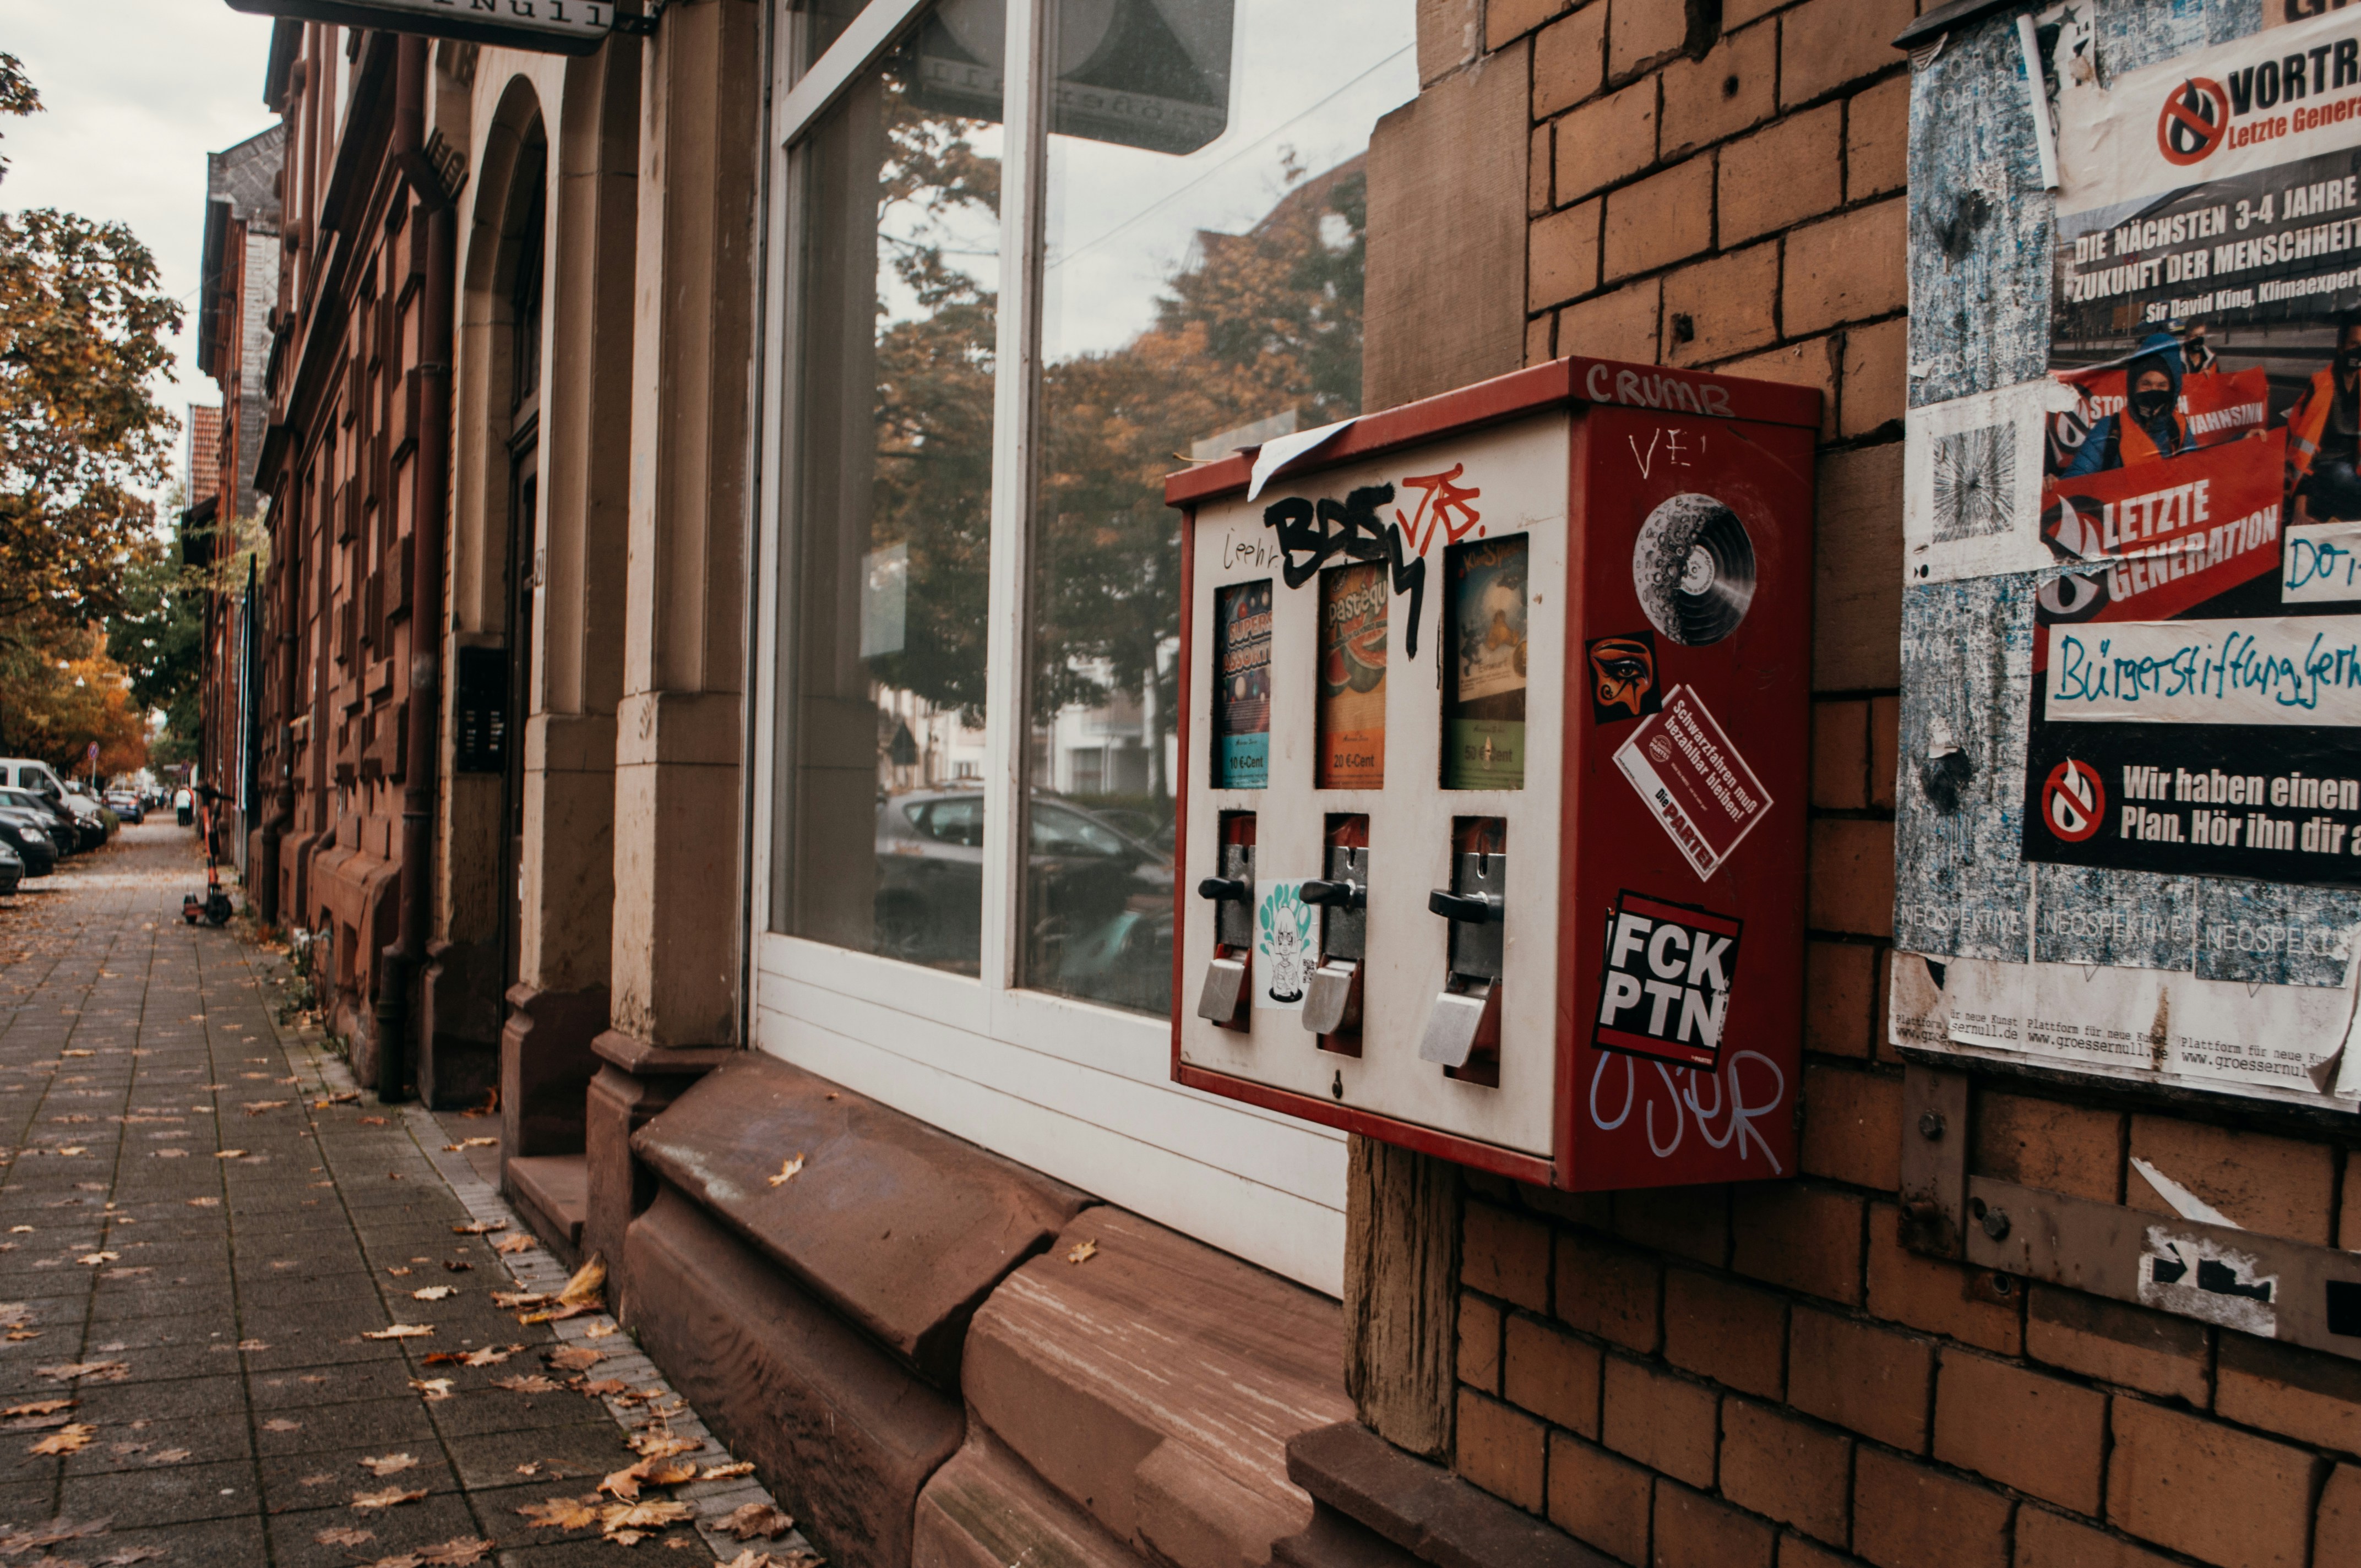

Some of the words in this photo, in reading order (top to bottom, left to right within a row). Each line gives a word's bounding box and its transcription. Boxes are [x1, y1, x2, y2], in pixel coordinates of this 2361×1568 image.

[434, 0, 608, 27] Null
[2228, 37, 2361, 117] VORTR
[2227, 116, 2287, 150] Letzte
[2075, 231, 2108, 265] DIE
[2115, 205, 2227, 255] NÄCHSTEN
[2235, 194, 2274, 231] 3-4
[2282, 175, 2357, 220] JAHRE
[2072, 258, 2169, 303] ZUKUNFT
[2166, 248, 2209, 284] DER
[2146, 303, 2169, 324] Sir
[2170, 294, 2213, 319] David
[2090, 395, 2127, 420] STO
[2103, 478, 2210, 549] LETZTE
[2107, 504, 2278, 603] GENERATION
[1229, 756, 1238, 769] 10
[1240, 754, 1263, 769] €-Cent
[1334, 754, 1344, 768] 20
[1346, 754, 1375, 767] €-Cent
[1664, 715, 1709, 775] bezahlbar
[1705, 772, 1744, 823] bleiben!
[1672, 699, 1737, 788] Schwarzfahren
[1733, 786, 1758, 814] muß
[1655, 787, 1670, 808] Die
[2123, 765, 2171, 801] Wir
[2175, 767, 2264, 805] haben
[2270, 772, 2360, 811] einen
[1661, 802, 1715, 871] PARTEI
[2120, 805, 2185, 843] Plan.
[2190, 809, 2243, 846] Hör
[2245, 813, 2295, 851] ihn
[2300, 816, 2347, 854] dir
[1610, 912, 1733, 992] FCK
[1599, 970, 1726, 1048] PTN
[1950, 1009, 1961, 1020] ür
[1965, 1012, 1986, 1023] neue
[1991, 1014, 2018, 1026] Kunst
[2027, 1019, 2079, 1034] Plattform
[2085, 1025, 2102, 1037] für
[2107, 1030, 2131, 1041] neue
[2181, 1037, 2242, 1054] Plattform
[2248, 1044, 2267, 1057] für
[2273, 1049, 2302, 1061] neue
[2309, 1053, 2329, 1064] Kun
[2182, 1052, 2311, 1079] www.groessernul
